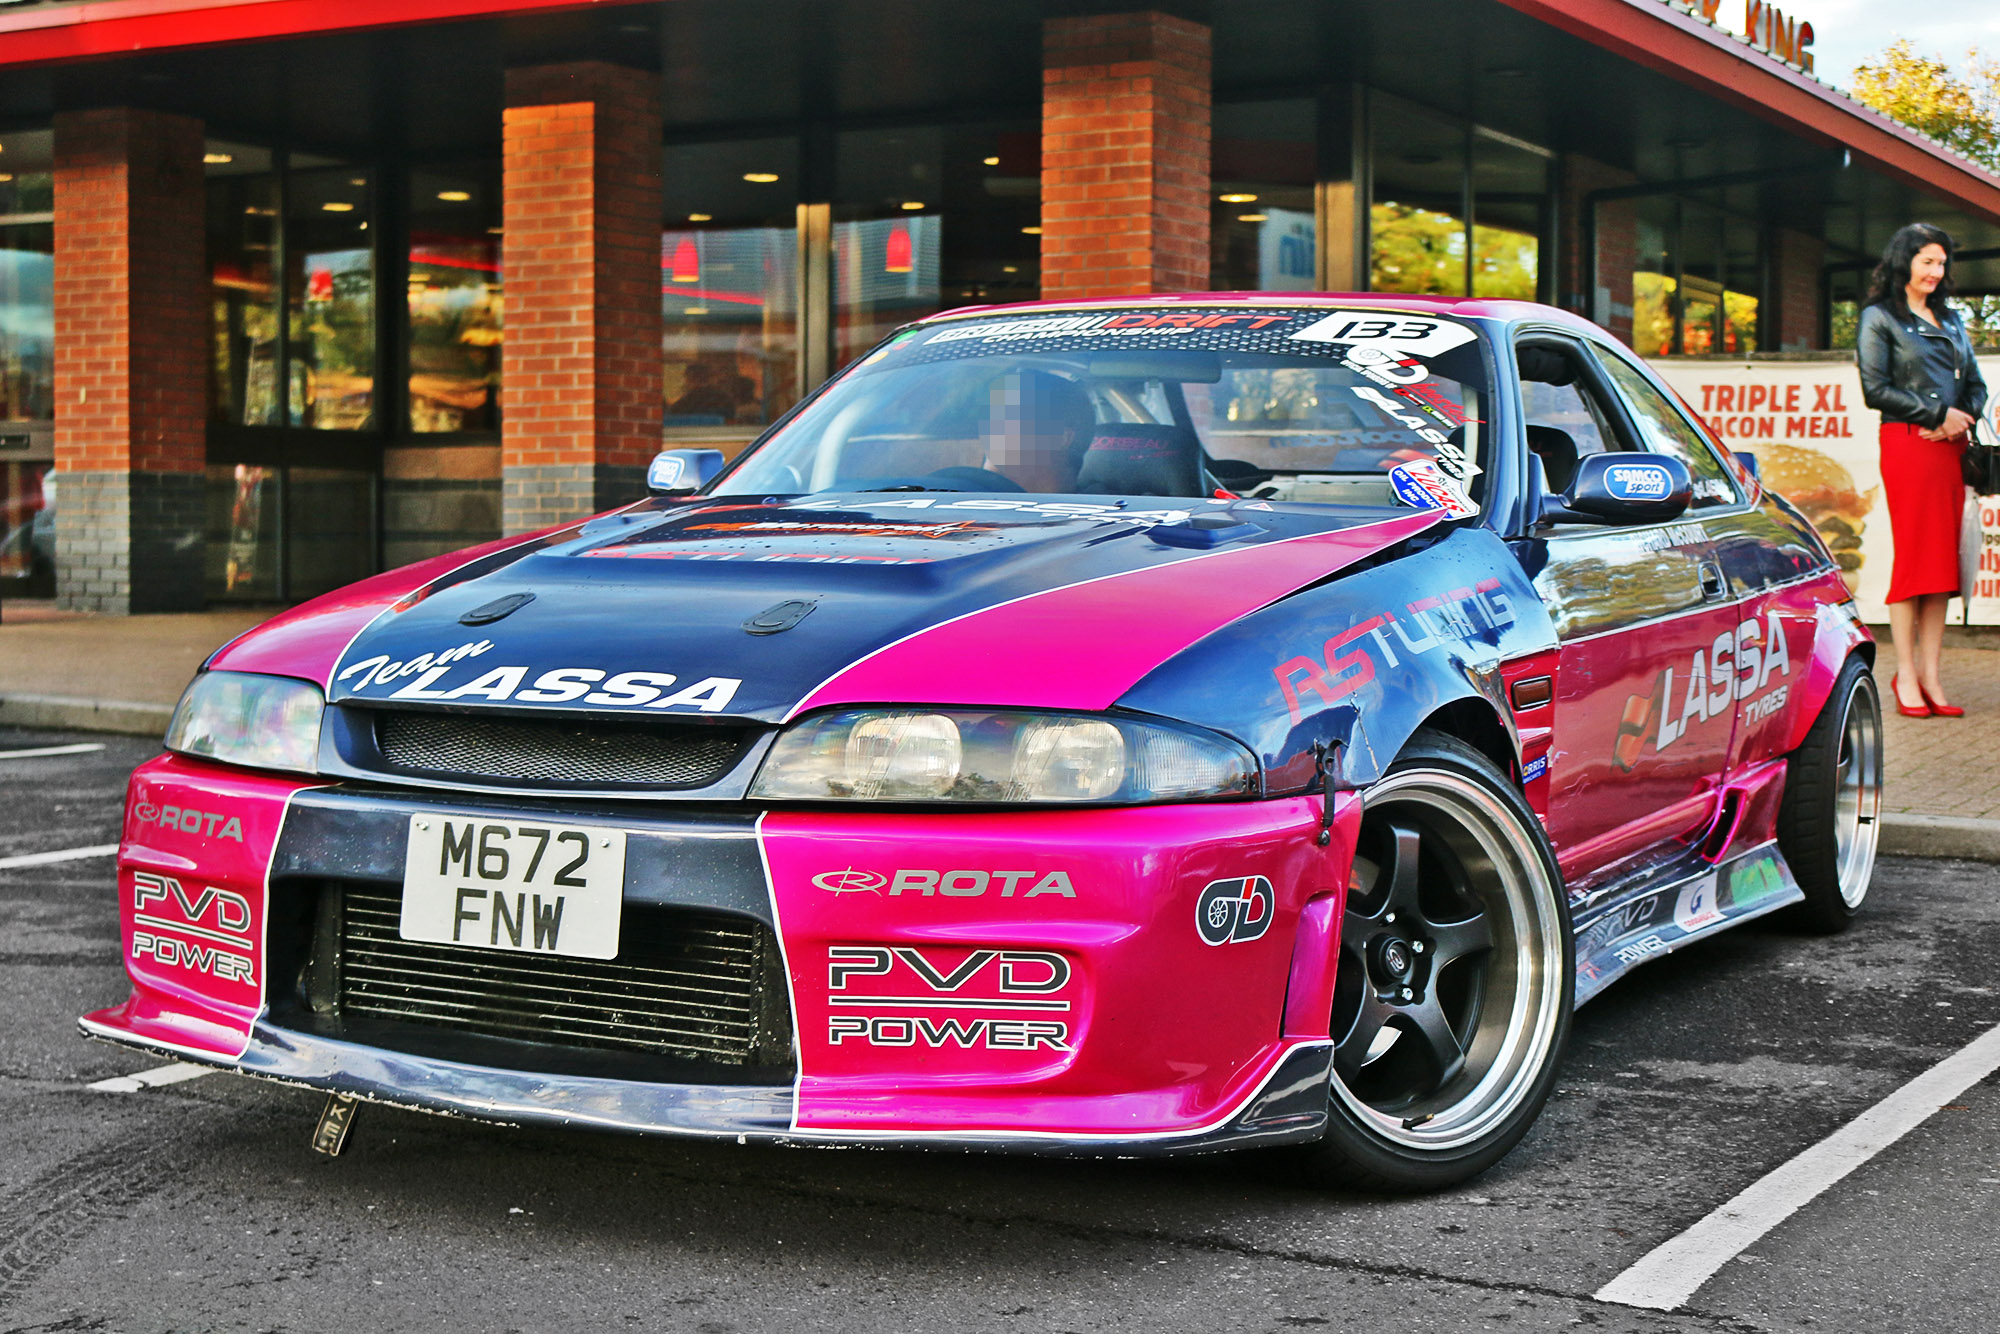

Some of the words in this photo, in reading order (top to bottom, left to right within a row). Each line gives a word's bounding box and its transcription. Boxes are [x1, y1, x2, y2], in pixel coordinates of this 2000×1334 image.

[1745, 0, 1814, 75] KING
[982, 327, 1195, 343] CHAMPIONSHIP
[1103, 314, 1292, 329] DRIFT
[1333, 321, 1438, 339] 133
[1701, 384, 1801, 412] TRIPLE
[1812, 384, 1847, 412] XL
[1373, 396, 1484, 477] LASSA
[1786, 416, 1853, 438] MEAL
[1433, 453, 1467, 480] TYRES
[1613, 469, 1664, 483] SAMCO
[1393, 470, 1409, 482] OIL
[1407, 481, 1442, 509] PRODUC
[1402, 489, 1419, 502] INC
[1408, 471, 1465, 513] LUCAS
[1629, 481, 1660, 494] sport
[778, 498, 1190, 522] LASSA
[337, 639, 495, 692] Team
[1656, 609, 1790, 752] LASSA
[389, 666, 743, 712] LASSA
[1745, 684, 1788, 728] TYRES
[1523, 757, 1546, 777] ORRIS
[159, 805, 243, 842] ROTA
[440, 822, 590, 887] M672
[888, 869, 1077, 898] ROTA
[134, 871, 251, 933] PVD
[453, 888, 565, 950] FNW
[132, 931, 258, 987] POWER
[1613, 935, 1667, 965] POWER
[829, 946, 1071, 994] PVD
[829, 1016, 1074, 1052] POWER
